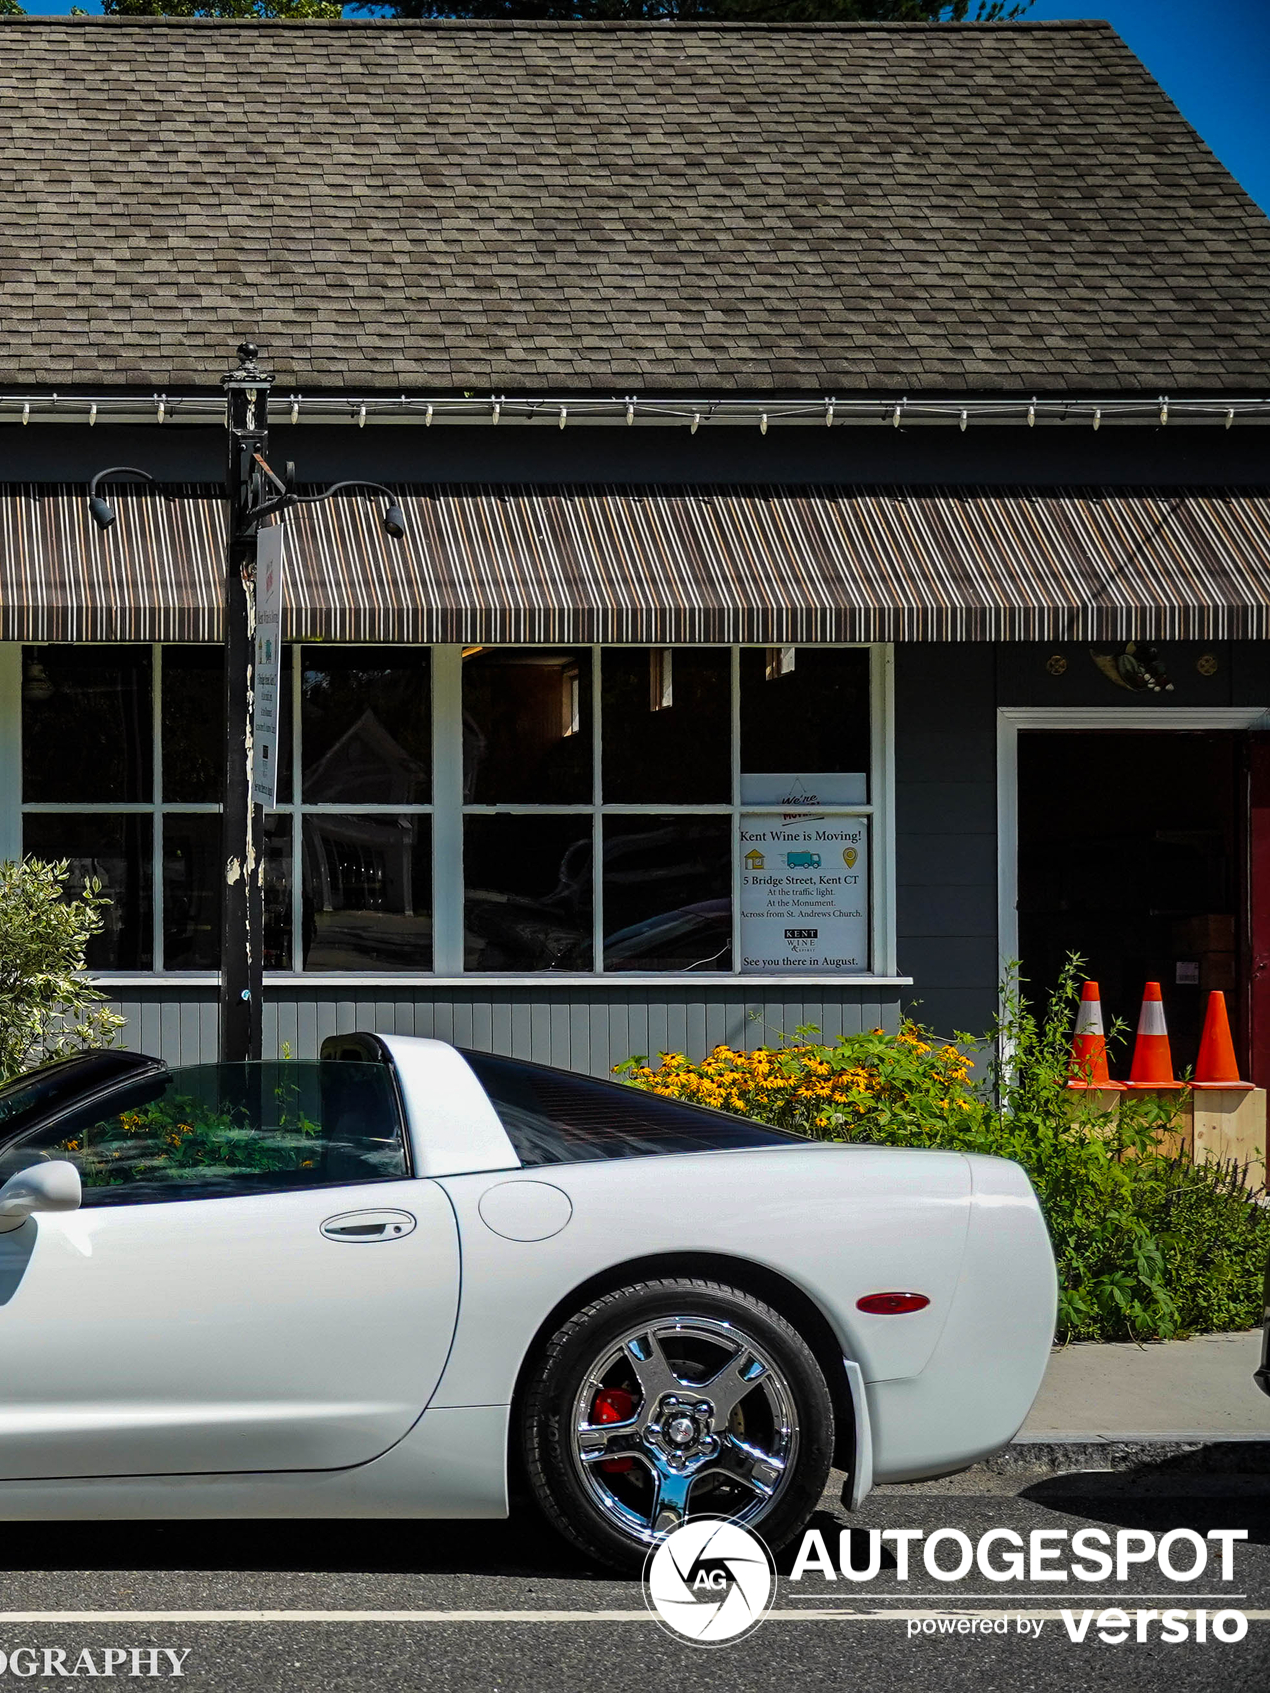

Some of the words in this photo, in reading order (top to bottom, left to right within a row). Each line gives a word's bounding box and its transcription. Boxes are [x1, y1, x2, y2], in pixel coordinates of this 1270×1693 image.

[782, 794, 818, 805] We're
[740, 831, 767, 841] Kent
[770, 831, 800, 841] Wine
[803, 831, 812, 841] is
[815, 831, 862, 844] Moving!
[743, 876, 749, 885] 5
[752, 876, 784, 887] Bridge
[785, 875, 817, 886] Street,
[819, 875, 842, 885] Kent
[844, 875, 860, 884] CT
[767, 888, 777, 896] At
[778, 888, 790, 896] the
[792, 887, 814, 896] traffic
[816, 887, 836, 898] light.
[766, 899, 776, 907] At
[777, 899, 790, 907] the
[791, 899, 836, 907] Monument.
[740, 910, 765, 918] Across
[766, 910, 785, 918] from
[786, 910, 796, 918] St.
[798, 910, 831, 918] Andrews
[832, 909, 863, 918] Church.
[786, 930, 816, 938] KENT
[791, 945, 799, 953] &
[743, 956, 759, 966] See
[762, 959, 779, 968] you
[782, 957, 807, 966] there
[809, 957, 819, 966] in
[822, 957, 859, 968] August.
